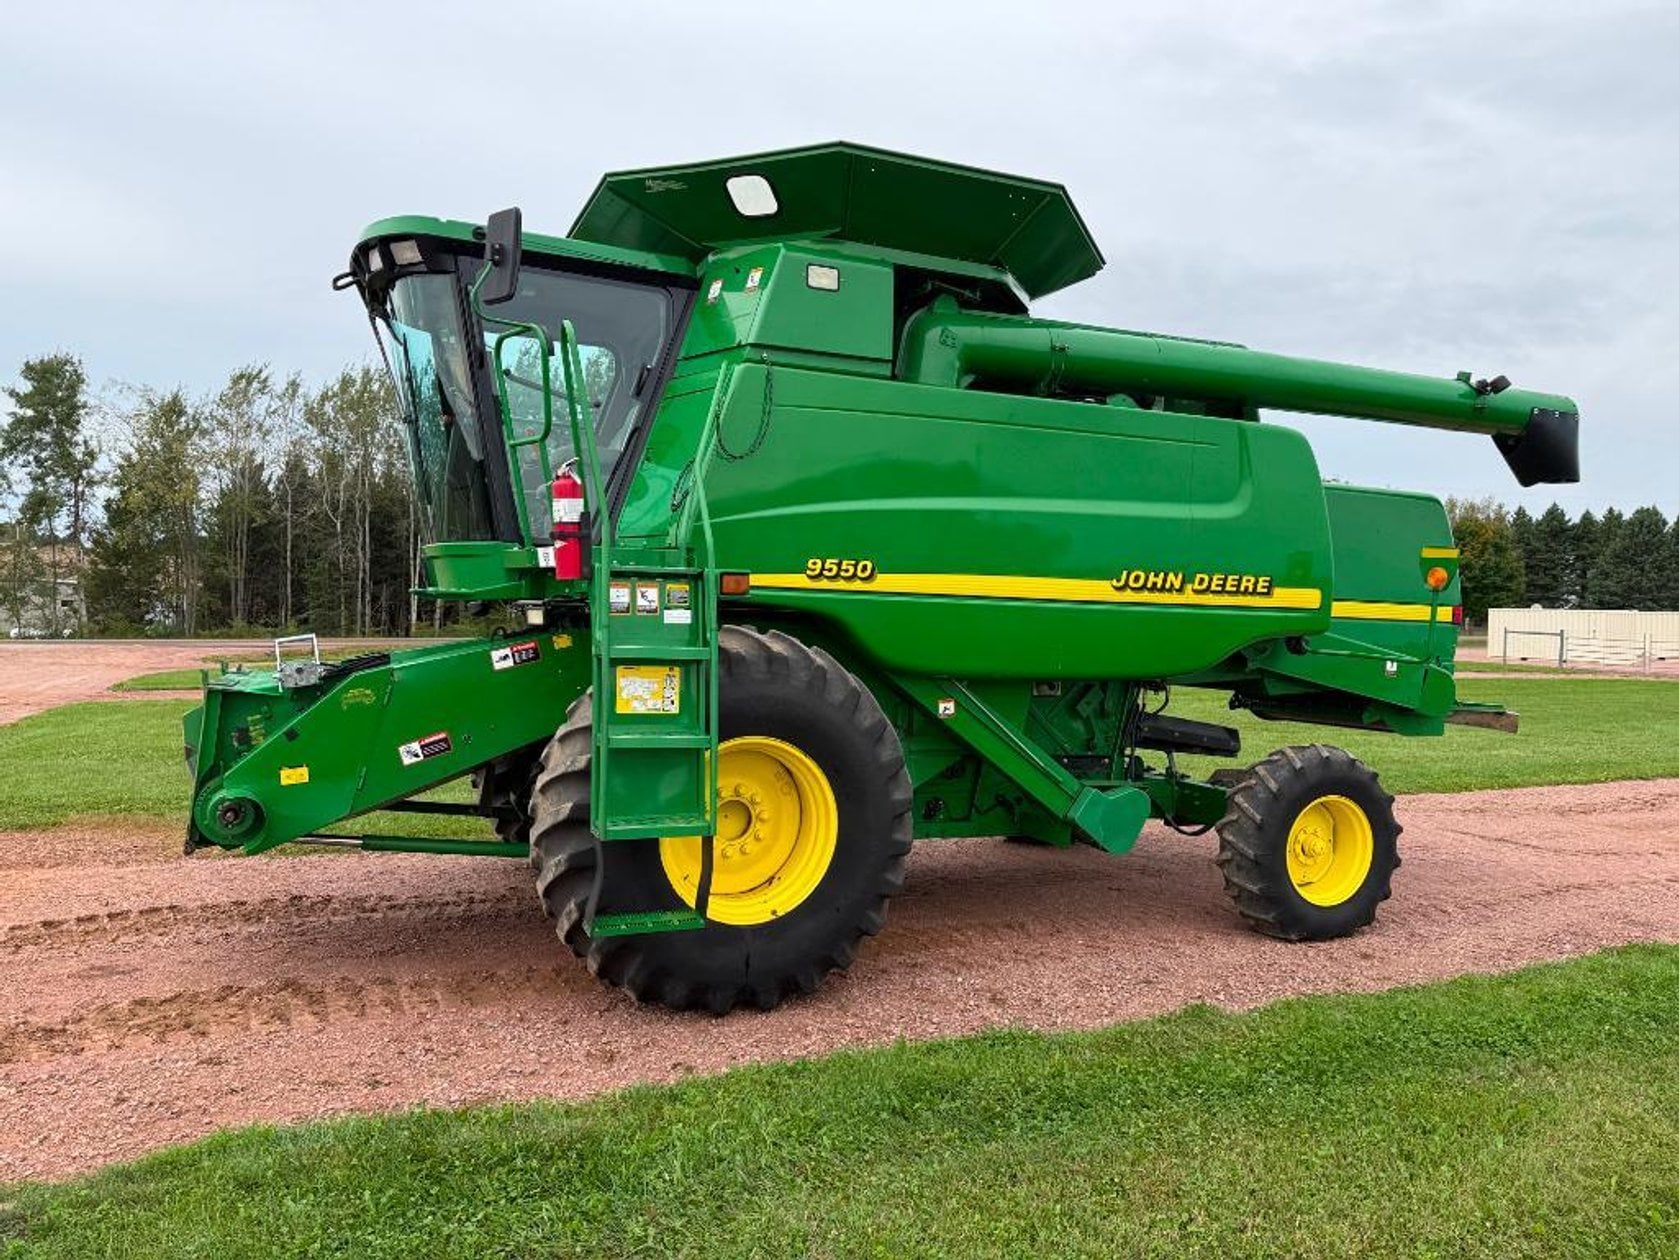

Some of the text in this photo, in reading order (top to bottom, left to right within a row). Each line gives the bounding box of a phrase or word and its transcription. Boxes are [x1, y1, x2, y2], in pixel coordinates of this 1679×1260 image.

[806, 558, 875, 580] 9550
[1112, 570, 1272, 595] JOHN DEERE
